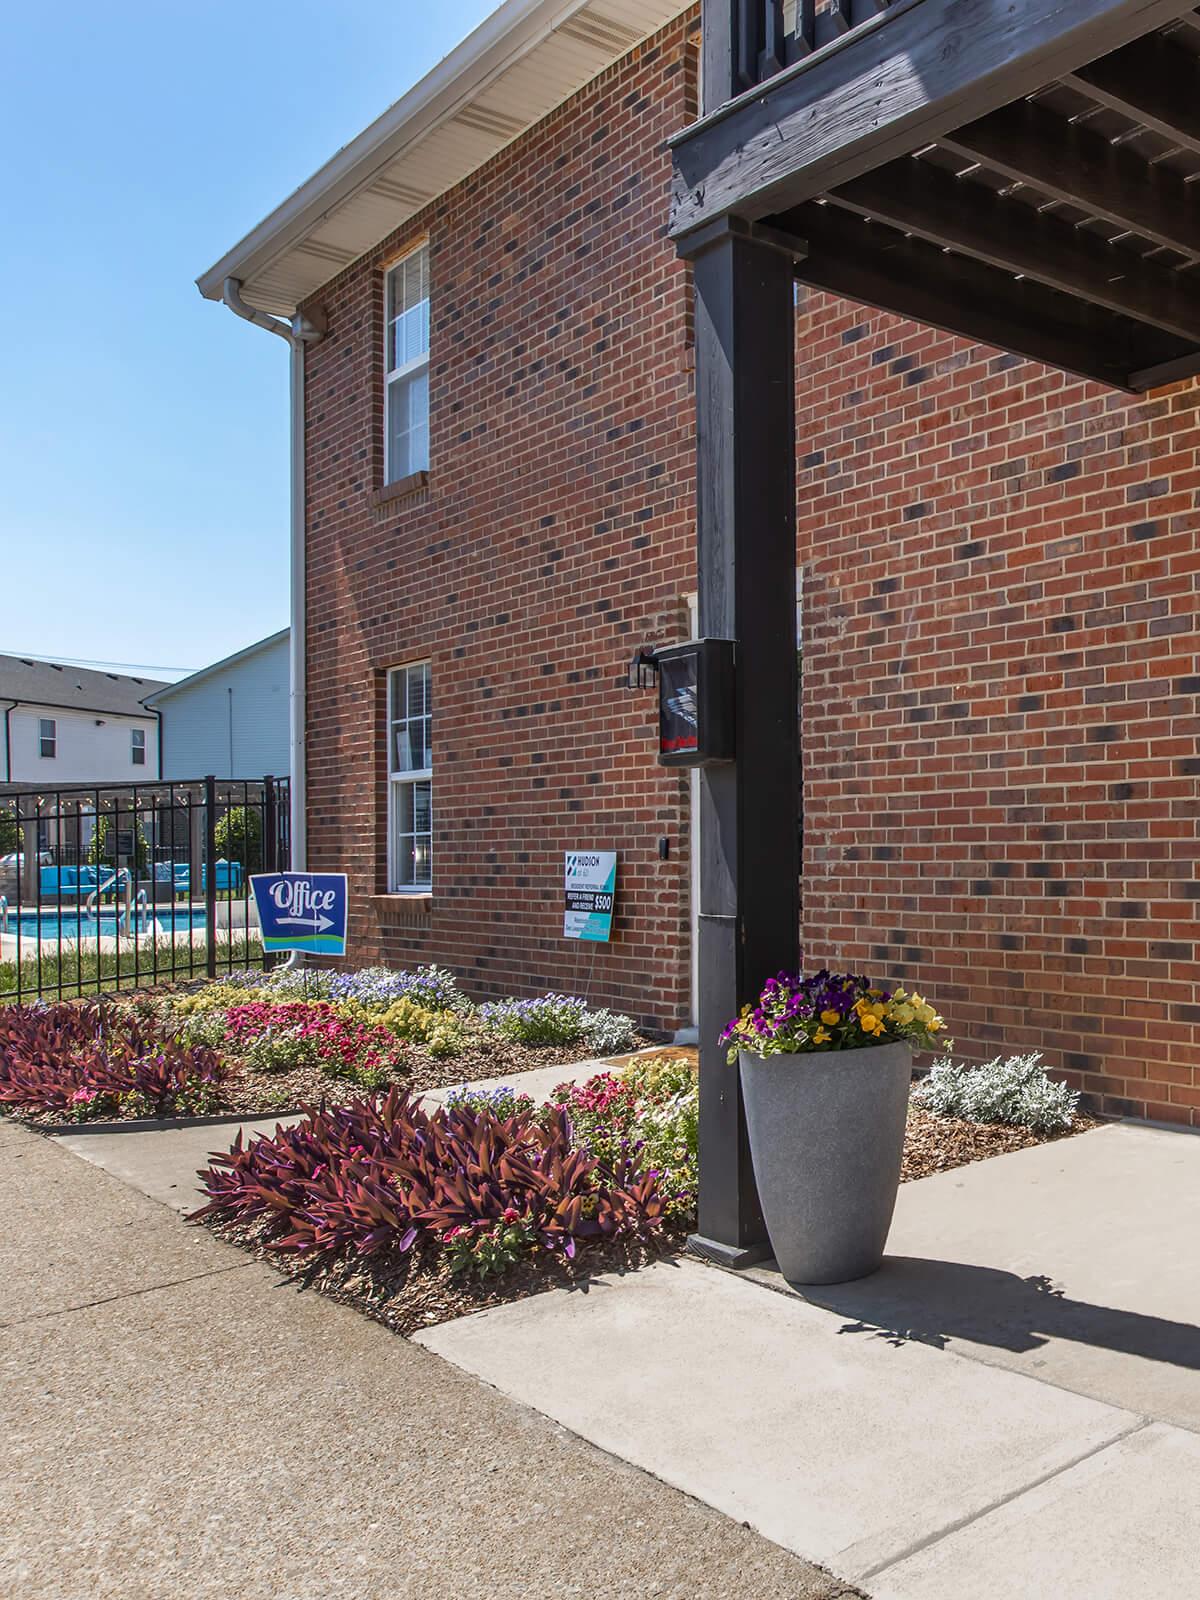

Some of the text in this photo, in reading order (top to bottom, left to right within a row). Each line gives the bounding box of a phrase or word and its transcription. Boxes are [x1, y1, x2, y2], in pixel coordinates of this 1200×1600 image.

[577, 856, 600, 866] HUDSON
[269, 880, 336, 917] Office
[594, 895, 611, 910] $500
